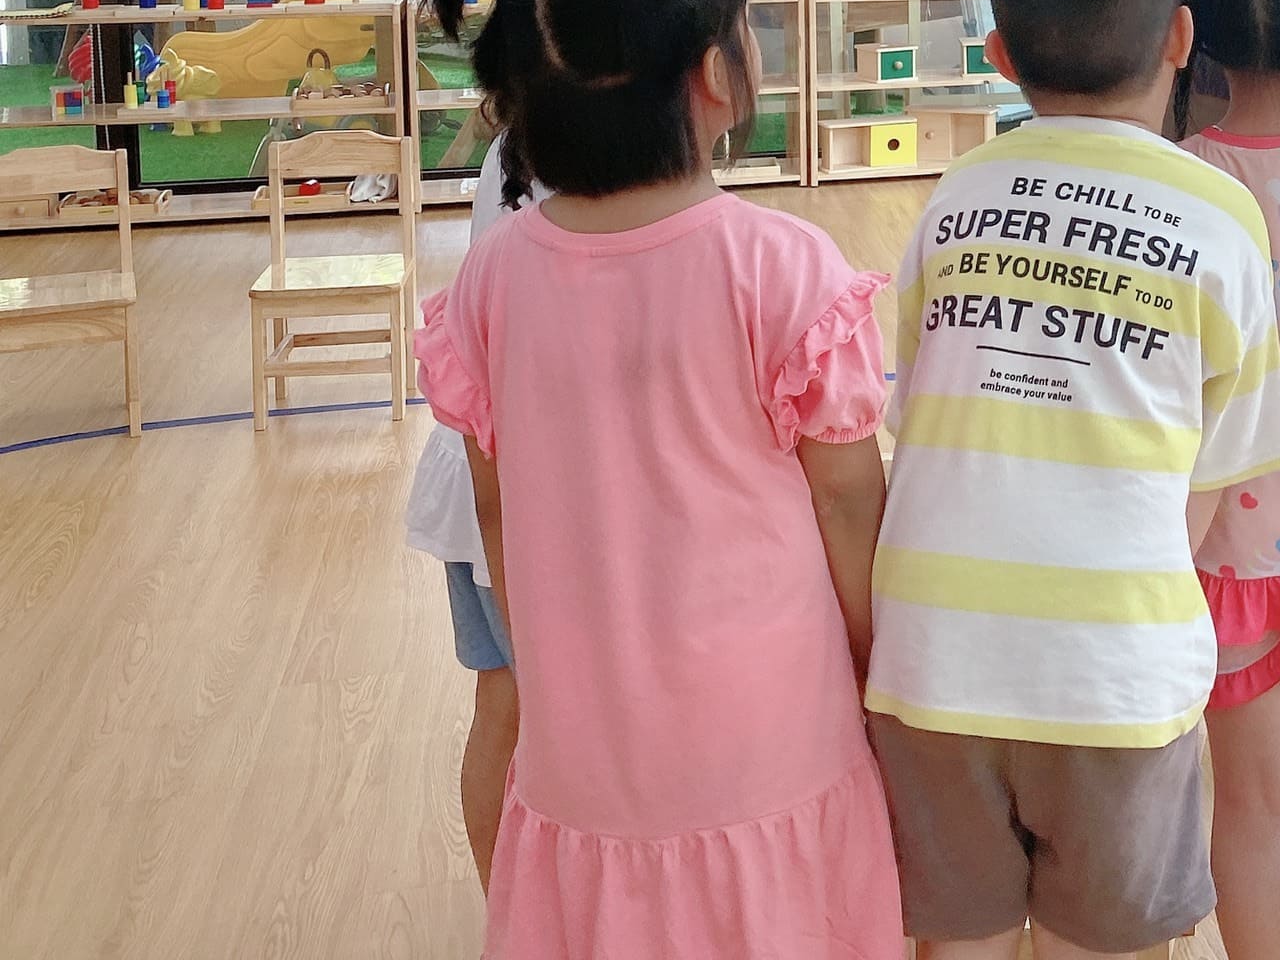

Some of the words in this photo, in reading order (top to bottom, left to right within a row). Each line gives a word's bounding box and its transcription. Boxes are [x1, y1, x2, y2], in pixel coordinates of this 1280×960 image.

[1011, 177, 1046, 197] BE
[1054, 182, 1138, 214] CHILL
[1143, 206, 1161, 218] TO
[1163, 212, 1182, 228] BE
[935, 209, 1051, 244] SUPER
[1062, 217, 1199, 276] FRESH
[937, 264, 954, 280] AND
[959, 253, 990, 274] BE
[995, 254, 1132, 296] YOURSELF
[1135, 289, 1151, 304] TO
[1154, 295, 1173, 310] DO
[926, 295, 1033, 332] GREAT
[1041, 306, 1169, 360] STUFF
[980, 384, 1021, 396] embrace
[1024, 389, 1045, 400] your
[1047, 391, 1072, 402] value
[990, 369, 1001, 380] be
[1004, 371, 1048, 388] confident
[1051, 378, 1069, 388] and
